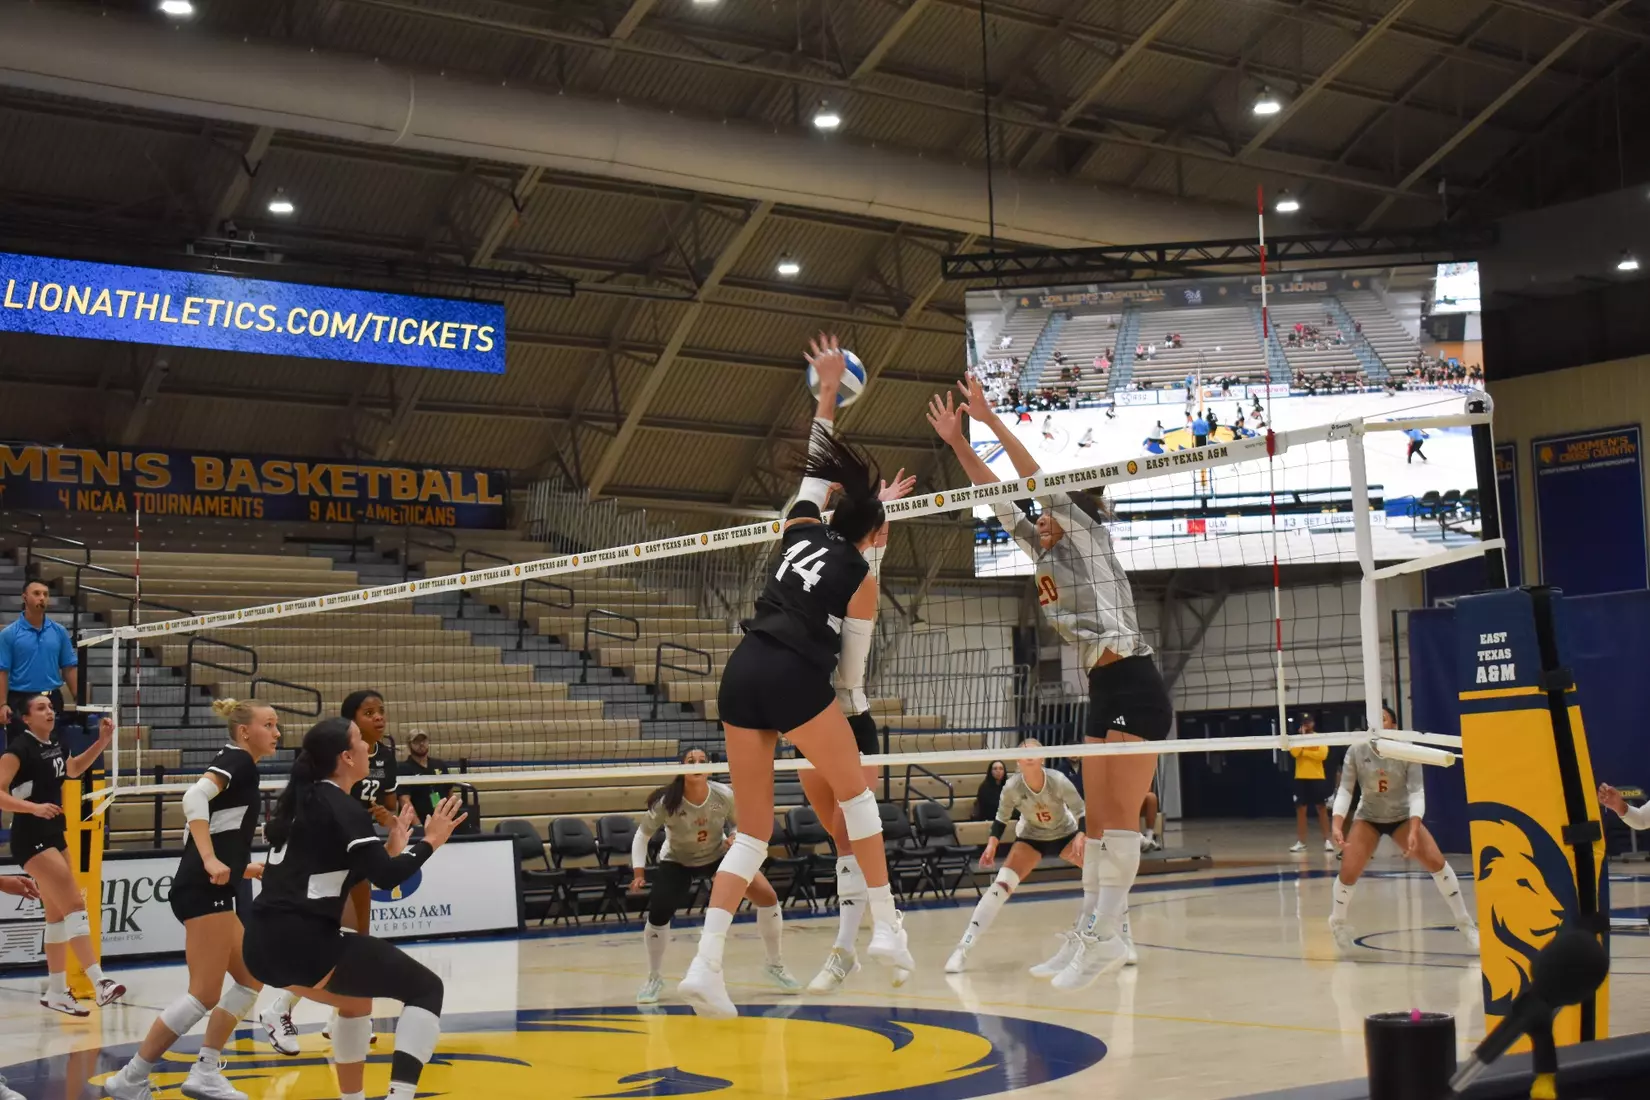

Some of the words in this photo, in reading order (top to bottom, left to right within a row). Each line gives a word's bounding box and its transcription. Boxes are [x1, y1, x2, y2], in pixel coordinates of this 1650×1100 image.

[4, 278, 495, 353] LIONATHLETICS.COM/TICKETS
[1146, 457, 1170, 470] EAST
[1172, 451, 1204, 465] TEXAS
[1207, 446, 1229, 459] A&M
[1593, 443, 1636, 458] COUNTRY
[0, 444, 171, 488] MEN'S
[191, 456, 503, 505] BASKETBALL
[1044, 476, 1066, 487] EAST
[1069, 470, 1098, 483] TEXAS
[1100, 466, 1119, 478] A&M
[951, 492, 970, 503] EAST
[973, 487, 1000, 499] TEXAS
[1002, 482, 1019, 494] A&M
[58, 489, 70, 510] 4
[77, 490, 127, 513] NCAA
[134, 492, 264, 518] TOURNAMENTS
[309, 501, 320, 522] 9
[886, 502, 910, 514] TEXAS
[912, 498, 929, 510] A&M
[1208, 519, 1228, 528] ULM
[713, 531, 730, 542] EAST
[731, 527, 751, 539] TEXAS
[753, 525, 768, 534] A&M
[645, 543, 660, 553] EAST
[662, 539, 681, 551] TEXAS
[682, 537, 696, 548] A&M
[583, 554, 597, 564] EAST
[598, 551, 616, 561] TEXAS
[618, 549, 629, 558] A&M
[524, 564, 538, 573] EAST
[539, 561, 555, 571] TEXAS
[775, 540, 829, 592] 14
[1480, 632, 1507, 645] EAST
[1477, 648, 1512, 661] TEXAS
[1476, 663, 1516, 683] A&M
[53, 757, 65, 778] 12
[360, 779, 380, 801] 22
[1378, 780, 1388, 792] 6
[1036, 811, 1052, 822] 15
[697, 830, 708, 842] 2
[370, 905, 416, 921] TEXAS
[419, 903, 452, 918] A&M
